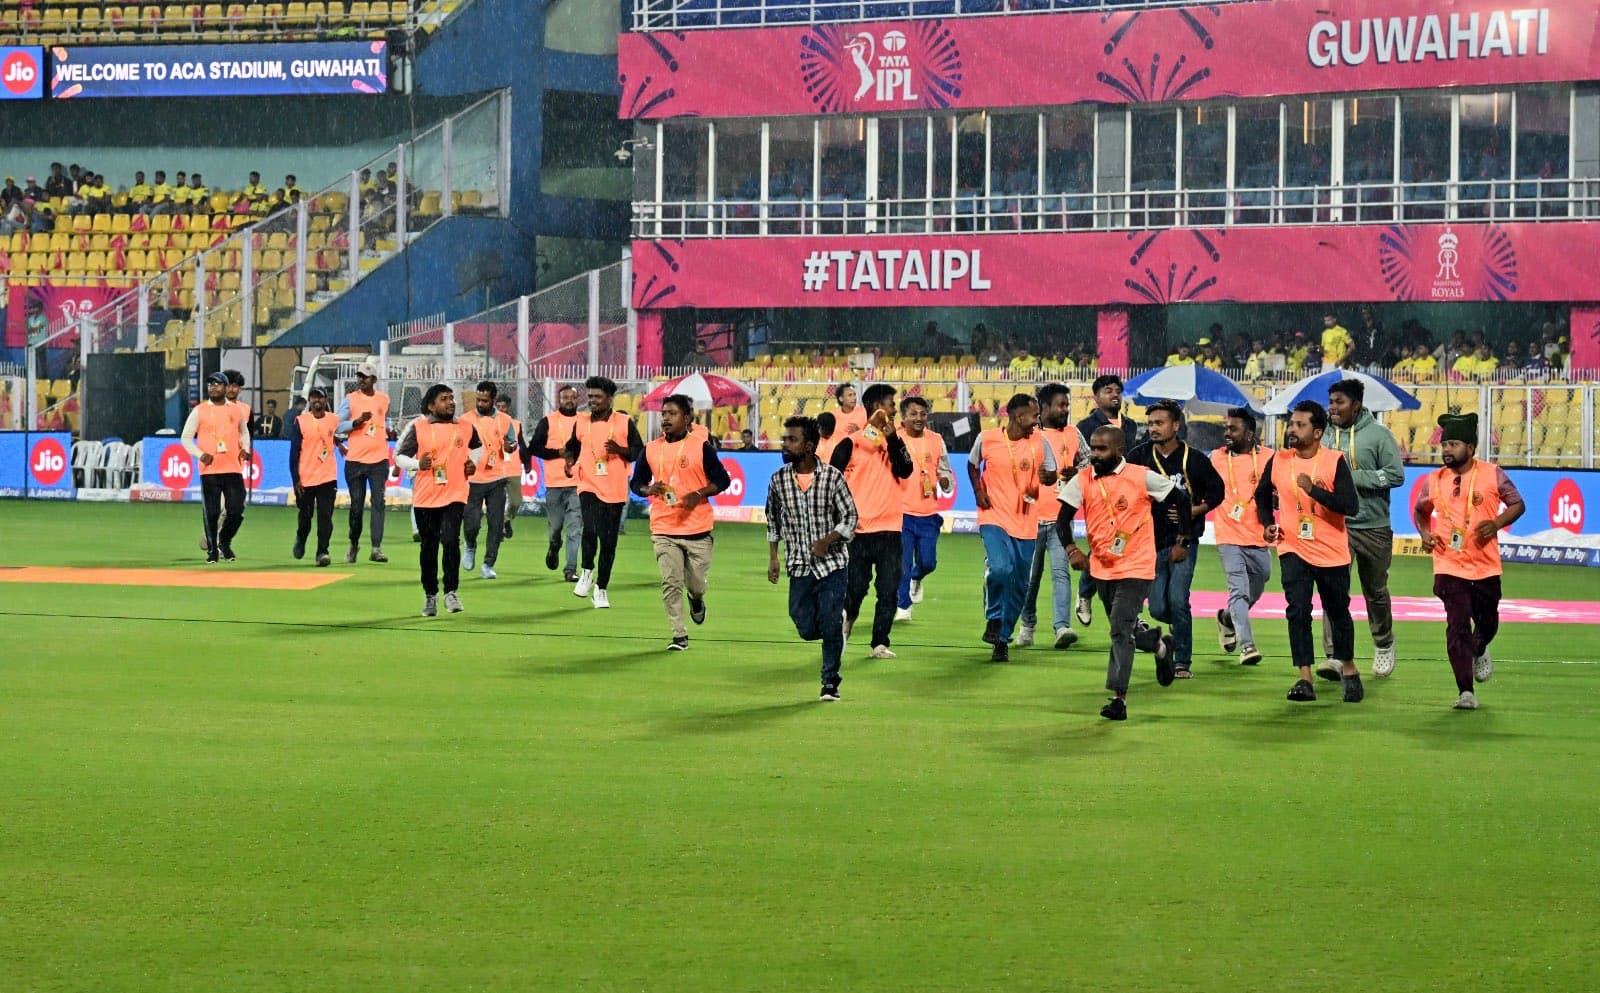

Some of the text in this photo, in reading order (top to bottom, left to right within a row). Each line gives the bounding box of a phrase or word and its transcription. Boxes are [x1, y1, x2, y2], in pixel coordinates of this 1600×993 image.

[1308, 9, 1549, 67] GUWAHATI
[5, 60, 35, 82] Jio
[56, 58, 380, 82] WELCOME TO ACA STADIUM, GUWAHATI
[878, 55, 910, 67] TATA
[876, 68, 919, 101] IPL
[803, 250, 991, 291] #TATAIPL
[1431, 287, 1465, 298] ROYALS
[34, 449, 64, 472] Jio
[162, 455, 191, 479] Jio
[242, 459, 260, 481] io
[521, 463, 538, 487] io
[1553, 494, 1582, 524] Jio
